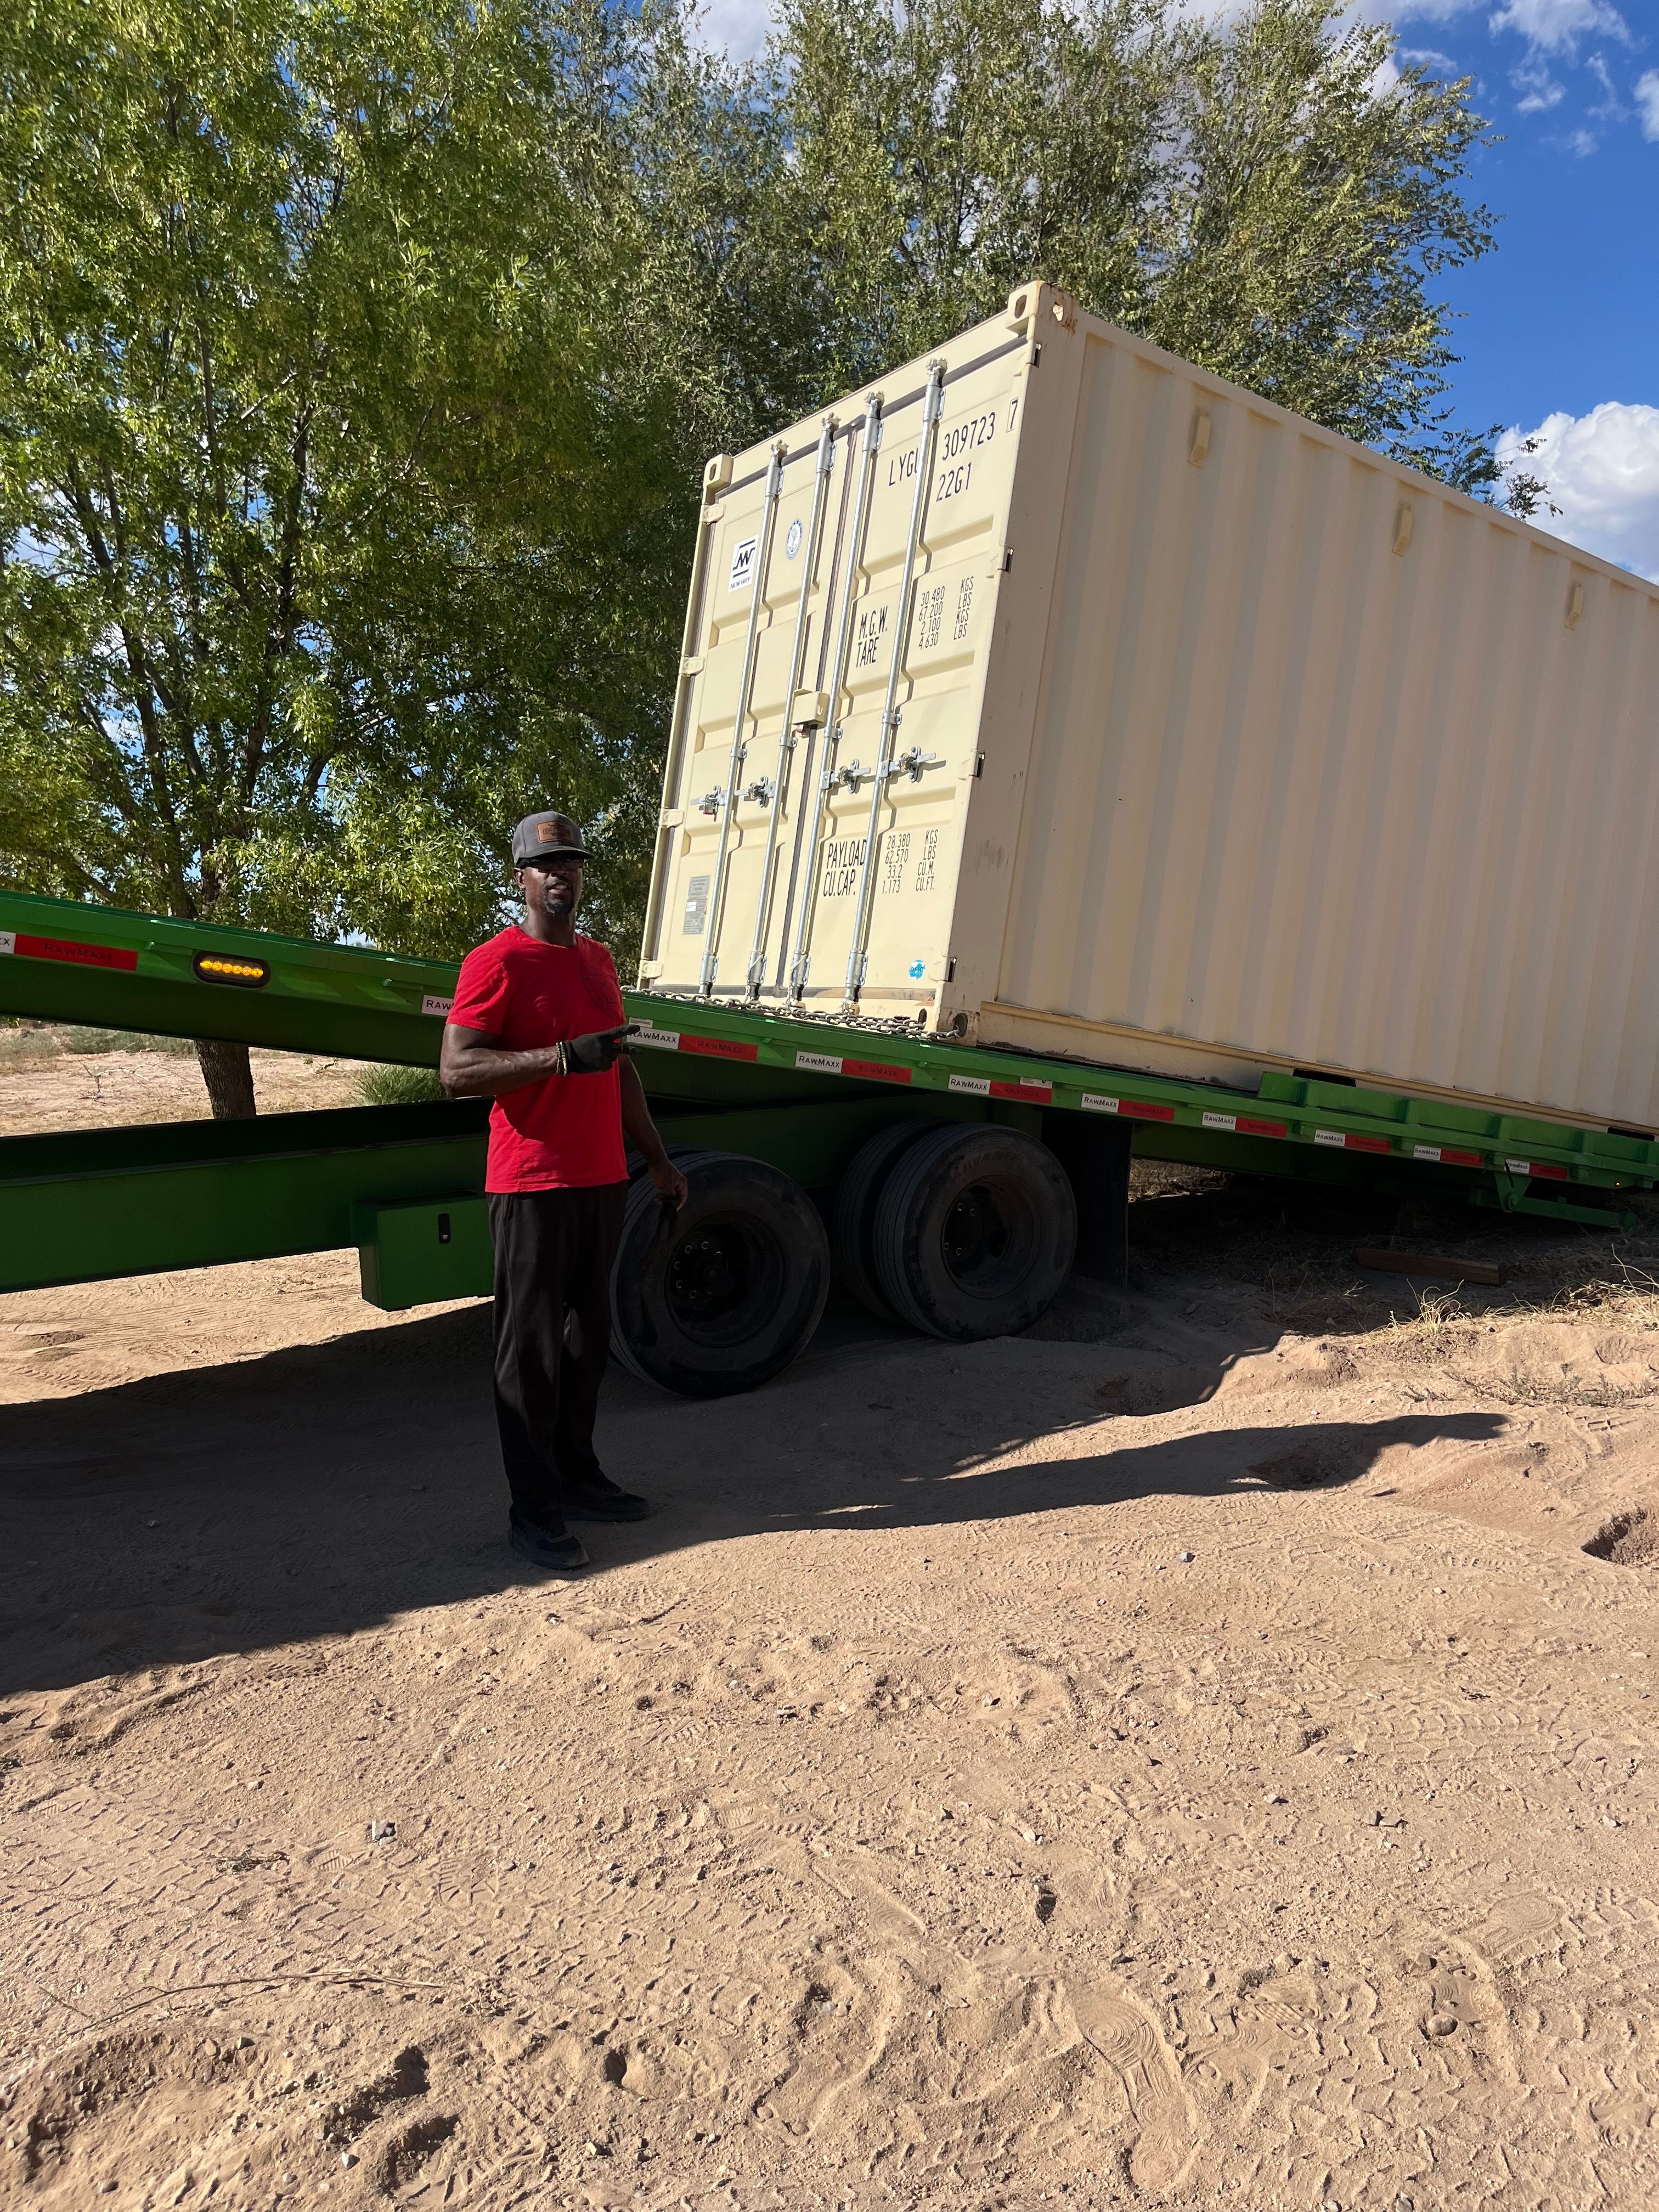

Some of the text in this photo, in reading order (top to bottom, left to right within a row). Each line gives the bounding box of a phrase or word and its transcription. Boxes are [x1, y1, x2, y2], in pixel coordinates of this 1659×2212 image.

[942, 411, 995, 461] 309723
[1010, 399, 1018, 430] 7
[936, 461, 972, 502] 22G1
[921, 585, 945, 606] 30.480
[960, 576, 974, 594] KGS
[919, 591, 972, 622] 67.200 LBS
[856, 607, 969, 668] TARE 2.100 KGS
[919, 623, 967, 650] 4.630 LBS
[826, 829, 939, 869] PAYLOAD 28.380 KGS
[885, 845, 936, 864] 62.570 LBS
[882, 879, 901, 894] 1.173
[887, 864, 903, 879] 33.2
